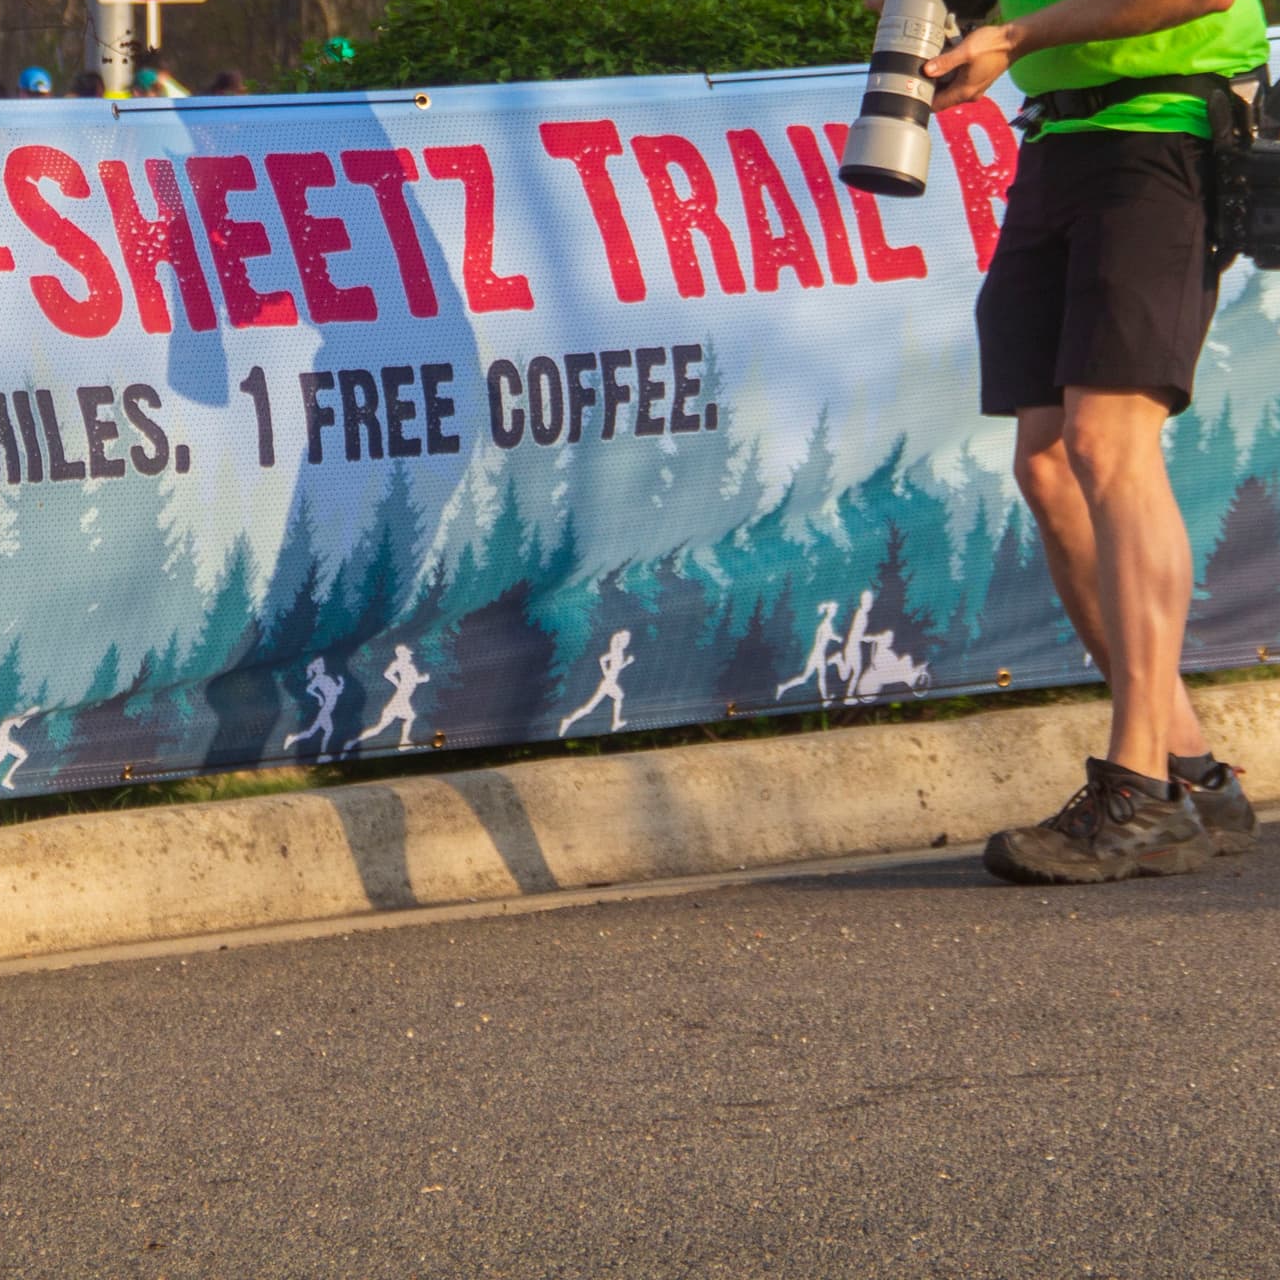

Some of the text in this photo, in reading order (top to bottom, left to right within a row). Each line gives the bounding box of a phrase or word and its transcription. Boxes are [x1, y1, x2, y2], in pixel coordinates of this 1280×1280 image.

[540, 119, 927, 303] TRAIL
[240, 364, 276, 468] 1
[301, 361, 461, 465] FREE
[486, 343, 719, 450] COFFEE.
